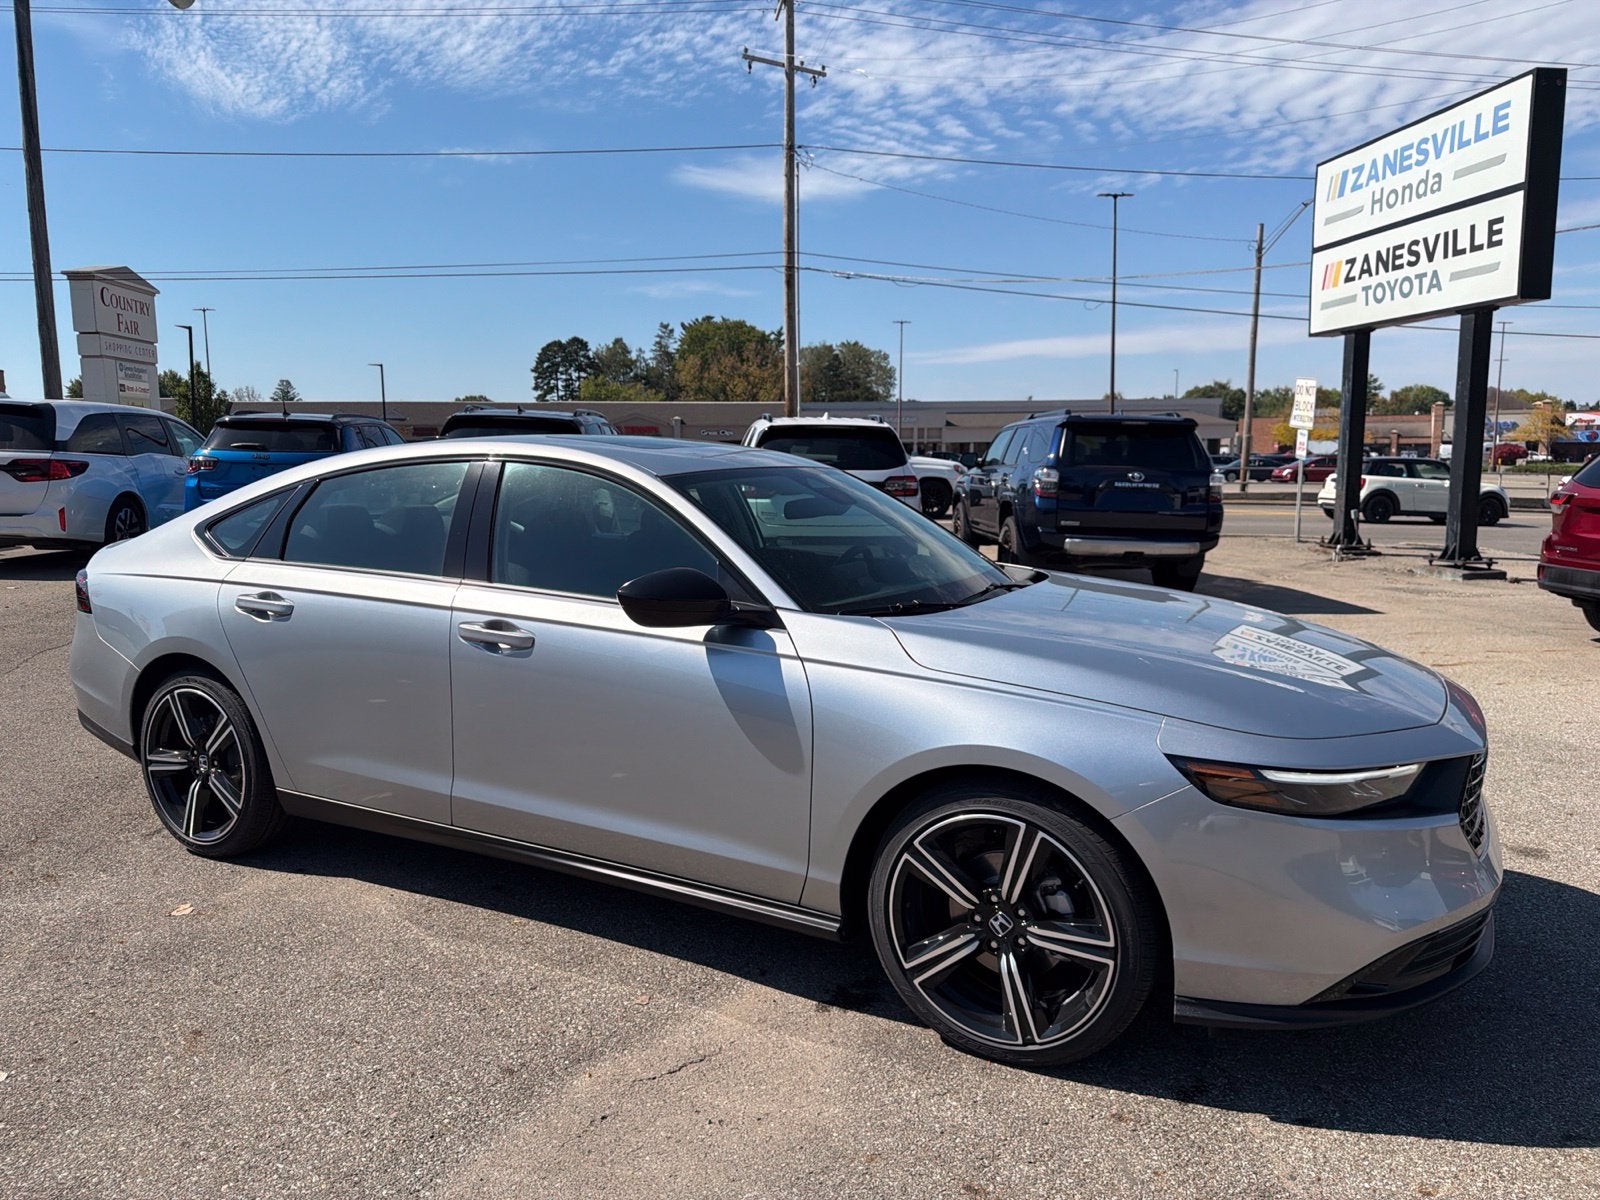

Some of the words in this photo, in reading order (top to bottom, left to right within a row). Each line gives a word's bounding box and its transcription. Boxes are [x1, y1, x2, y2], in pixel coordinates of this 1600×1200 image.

[1350, 100, 1512, 193] ZANESVILLE
[1370, 169, 1443, 216] Honda
[1344, 215, 1505, 284] ZANESVILLE
[1361, 269, 1443, 306] TOYOTA
[104, 341, 132, 354] SHOPPING
[134, 346, 155, 358] CENTER
[1295, 400, 1314, 412] BLOCK
[1296, 384, 1304, 395] DO
[1305, 385, 1316, 396] NOT
